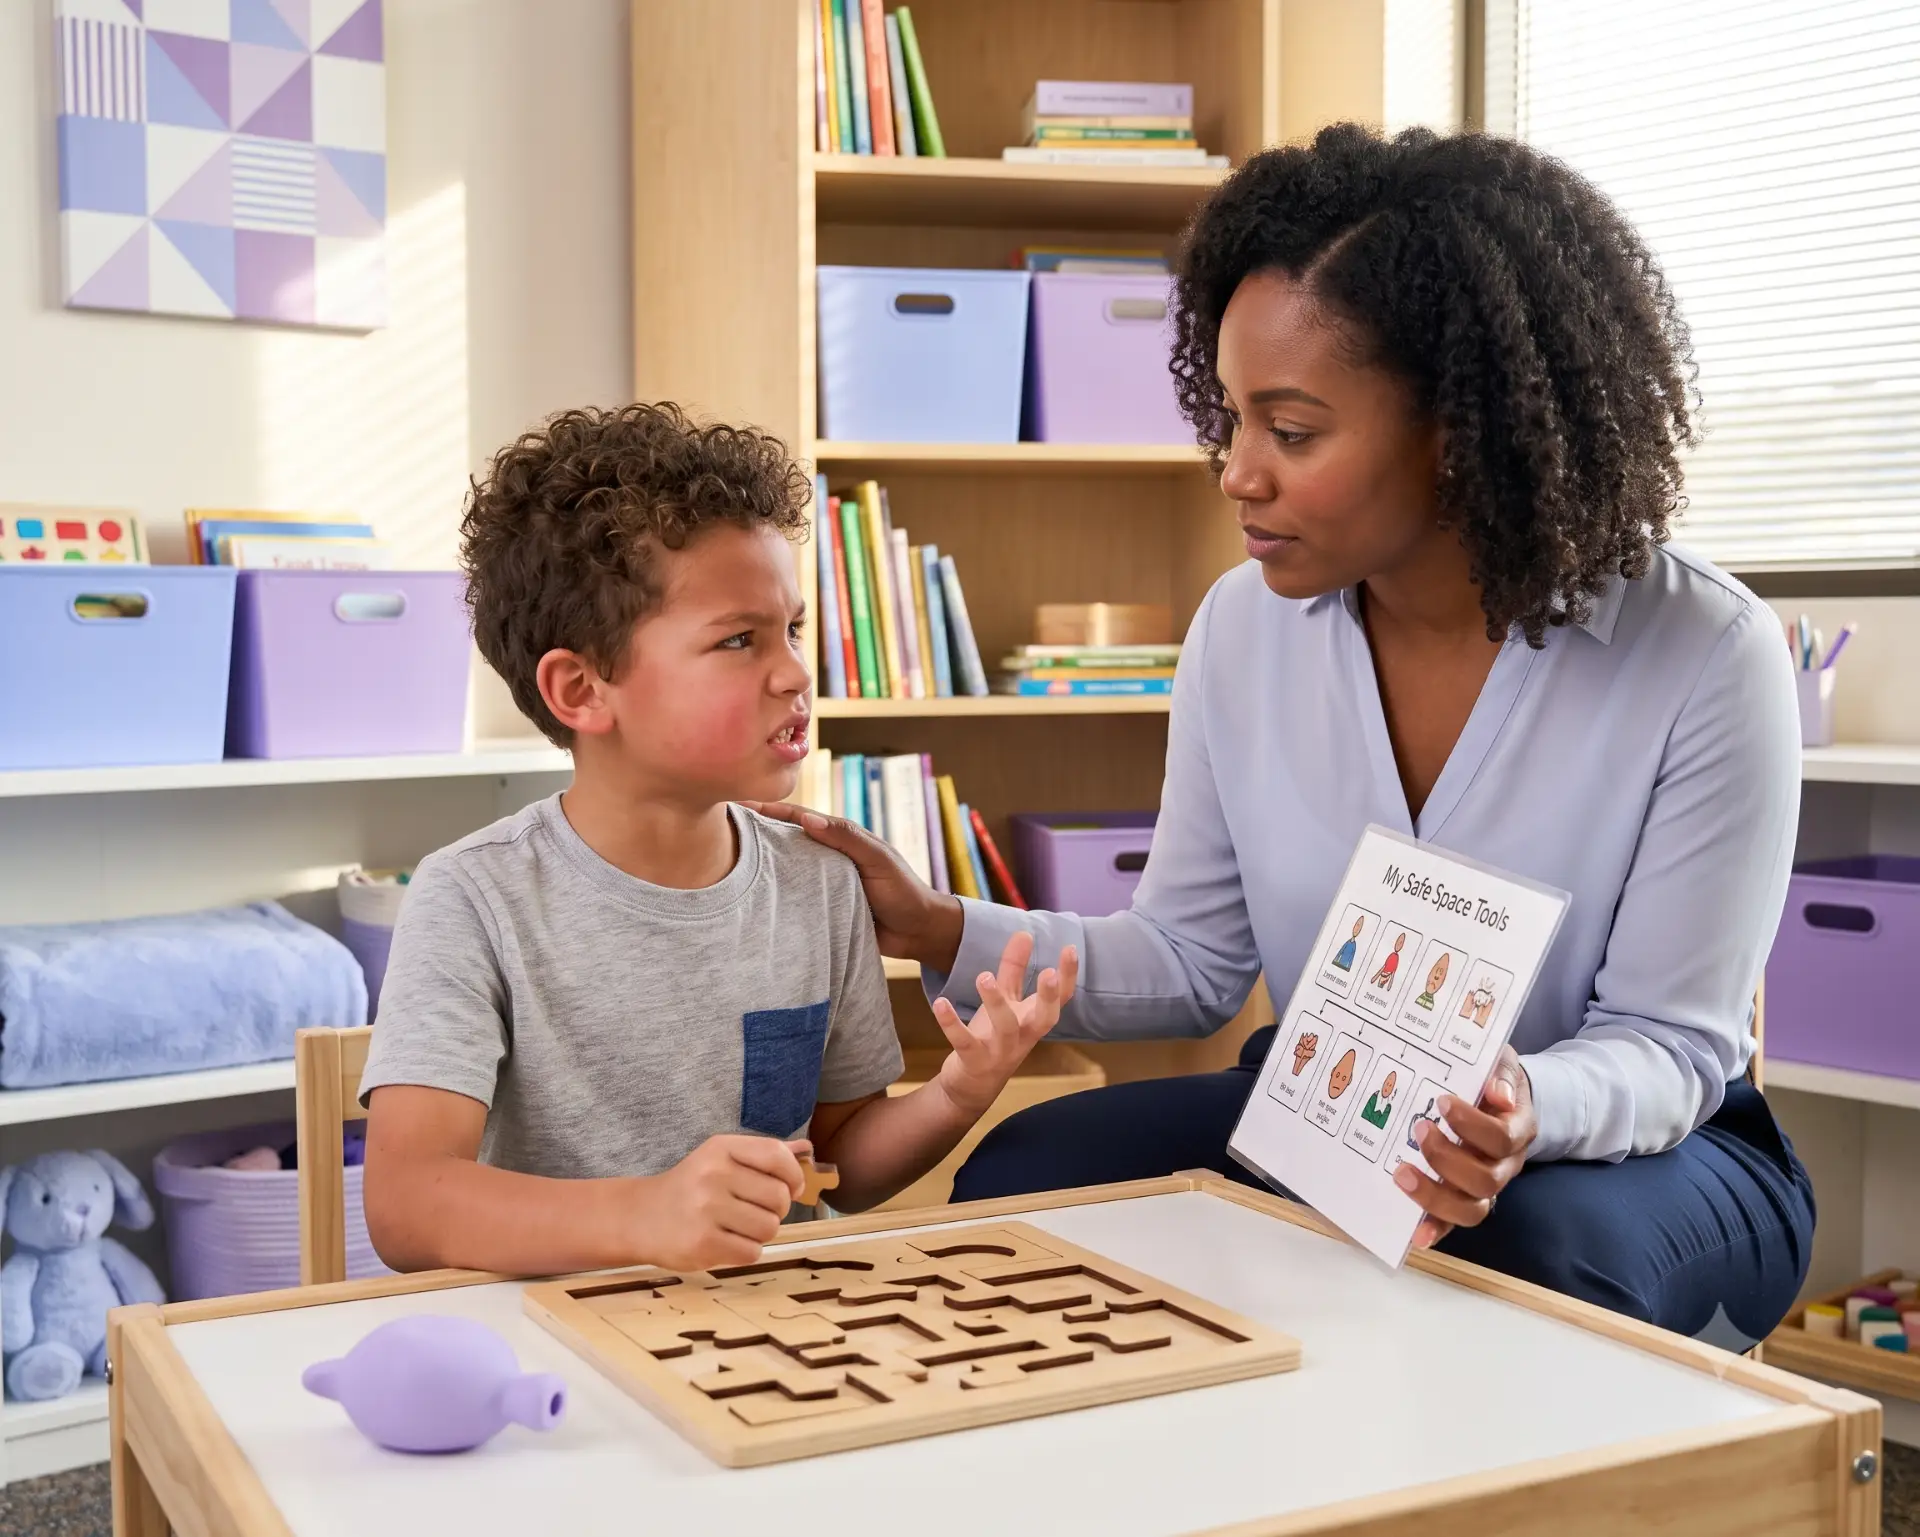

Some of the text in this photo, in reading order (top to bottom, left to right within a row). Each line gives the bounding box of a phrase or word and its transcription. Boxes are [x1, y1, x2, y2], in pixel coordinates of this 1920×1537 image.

[1382, 864, 1510, 932] My Safe Space Tools
